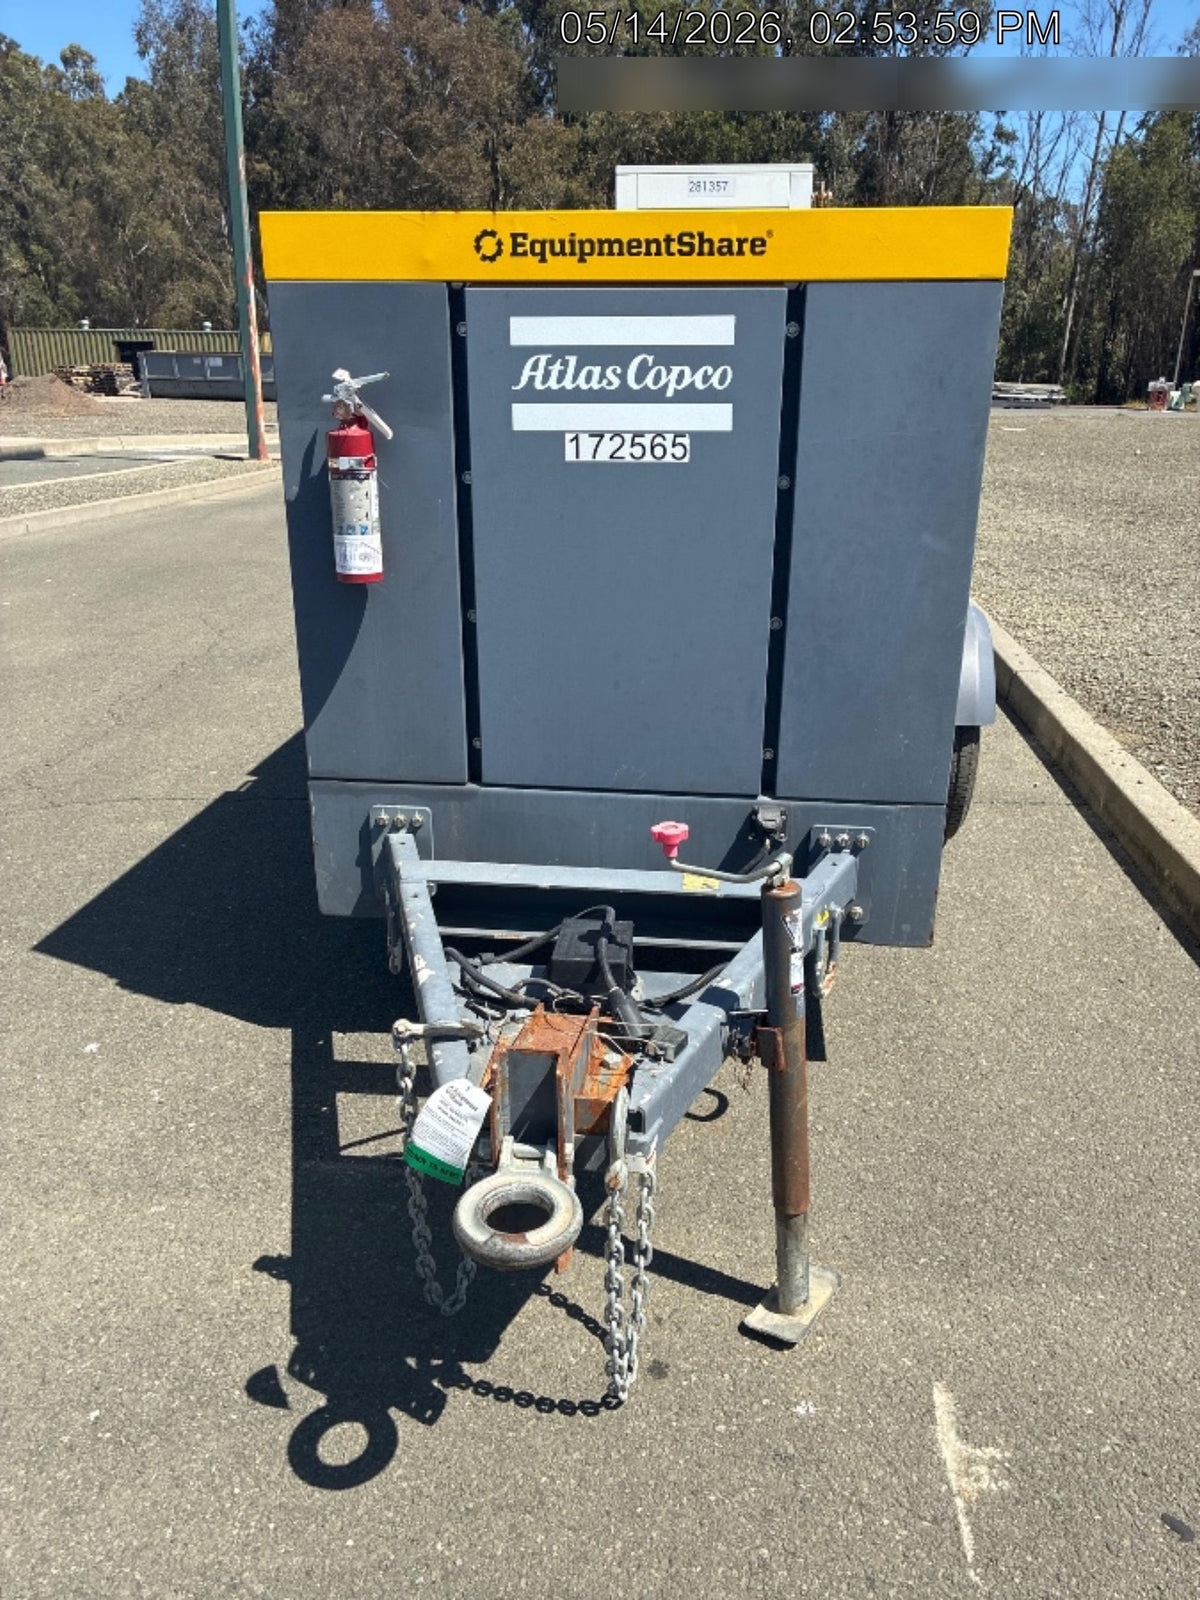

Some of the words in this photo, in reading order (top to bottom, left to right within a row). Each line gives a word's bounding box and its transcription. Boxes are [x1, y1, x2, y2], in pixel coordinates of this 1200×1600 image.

[689, 180, 729, 193] 281357
[509, 231, 768, 263] EquipmentShare
[511, 353, 622, 391] Atlas
[626, 353, 733, 398] Copco
[568, 432, 689, 461] 172565
